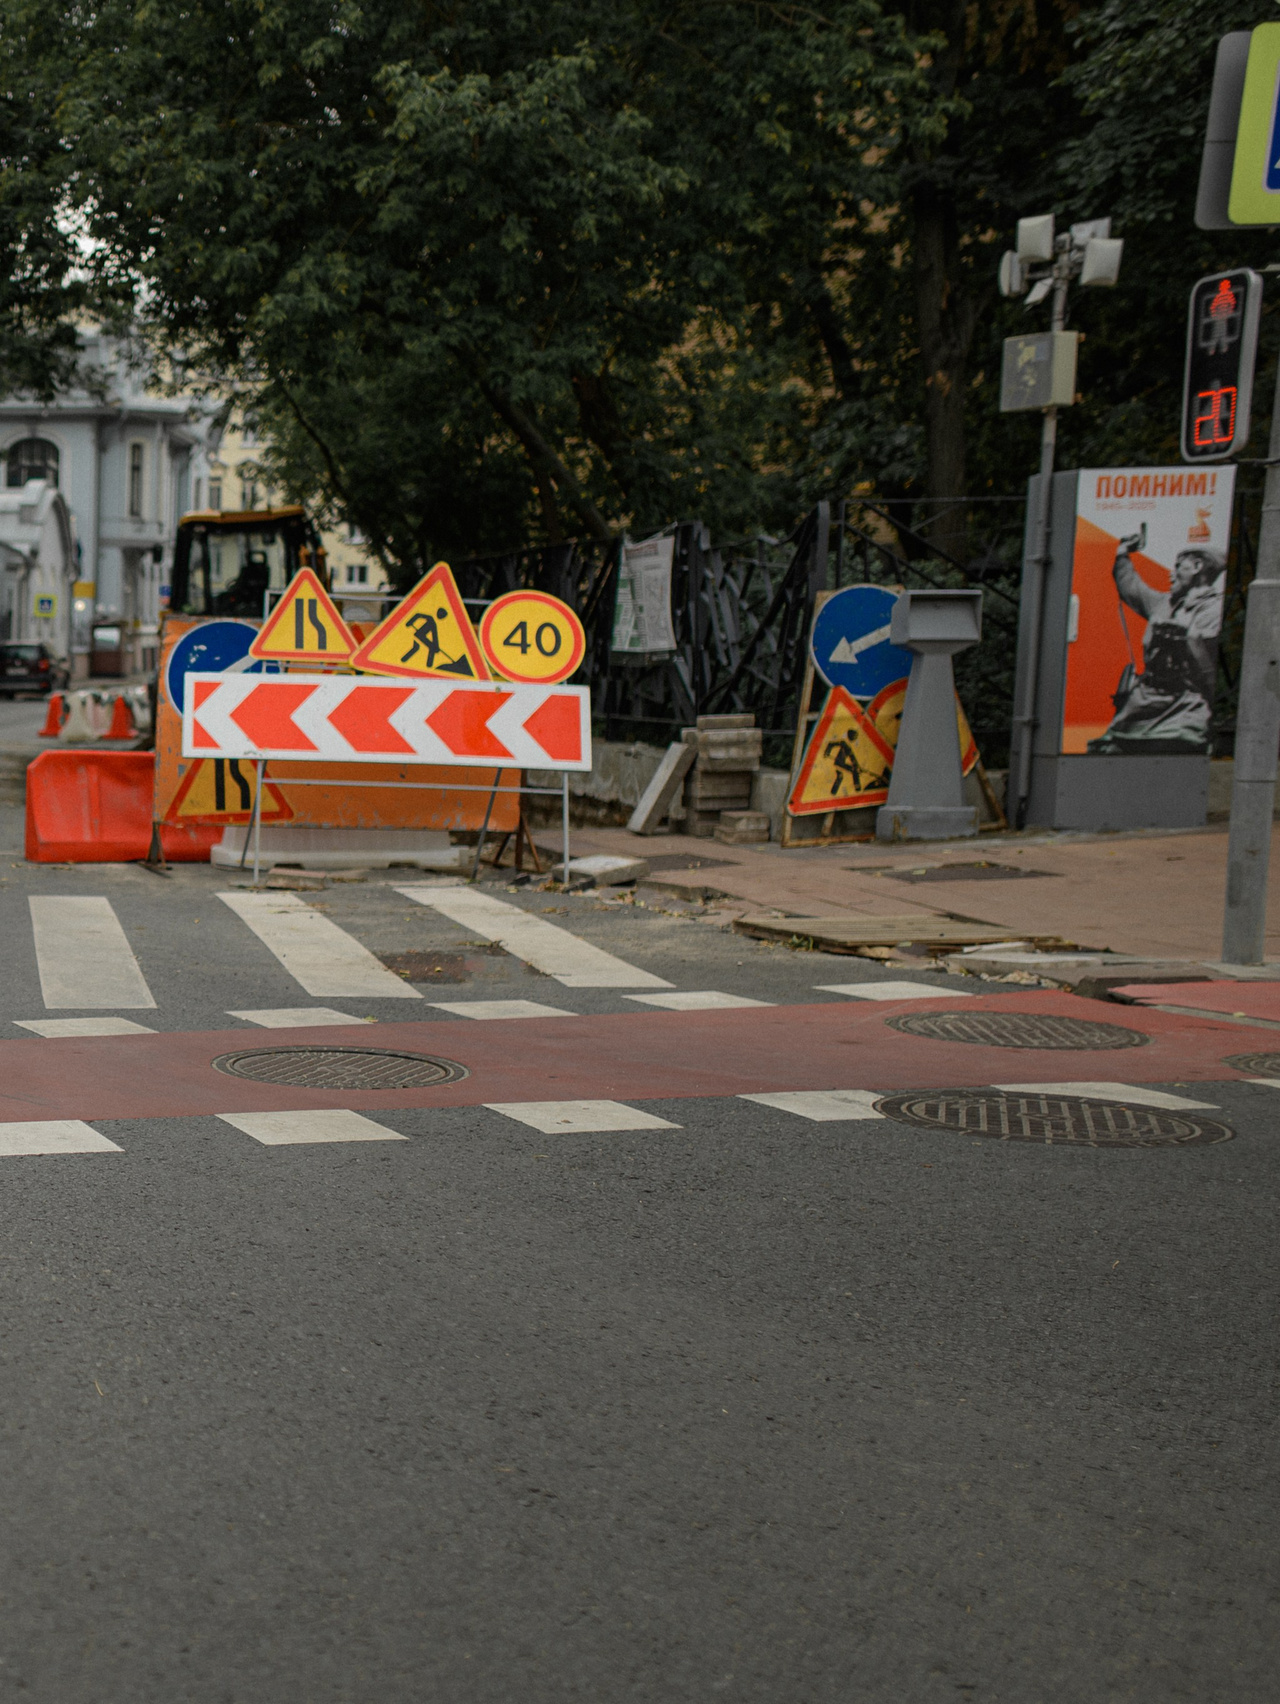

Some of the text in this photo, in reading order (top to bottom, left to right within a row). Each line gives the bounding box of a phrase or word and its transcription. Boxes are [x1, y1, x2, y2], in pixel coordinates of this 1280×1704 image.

[1194, 386, 1238, 446] 20
[1095, 472, 1218, 499] ПОМНИМ!
[503, 621, 562, 657] 40
